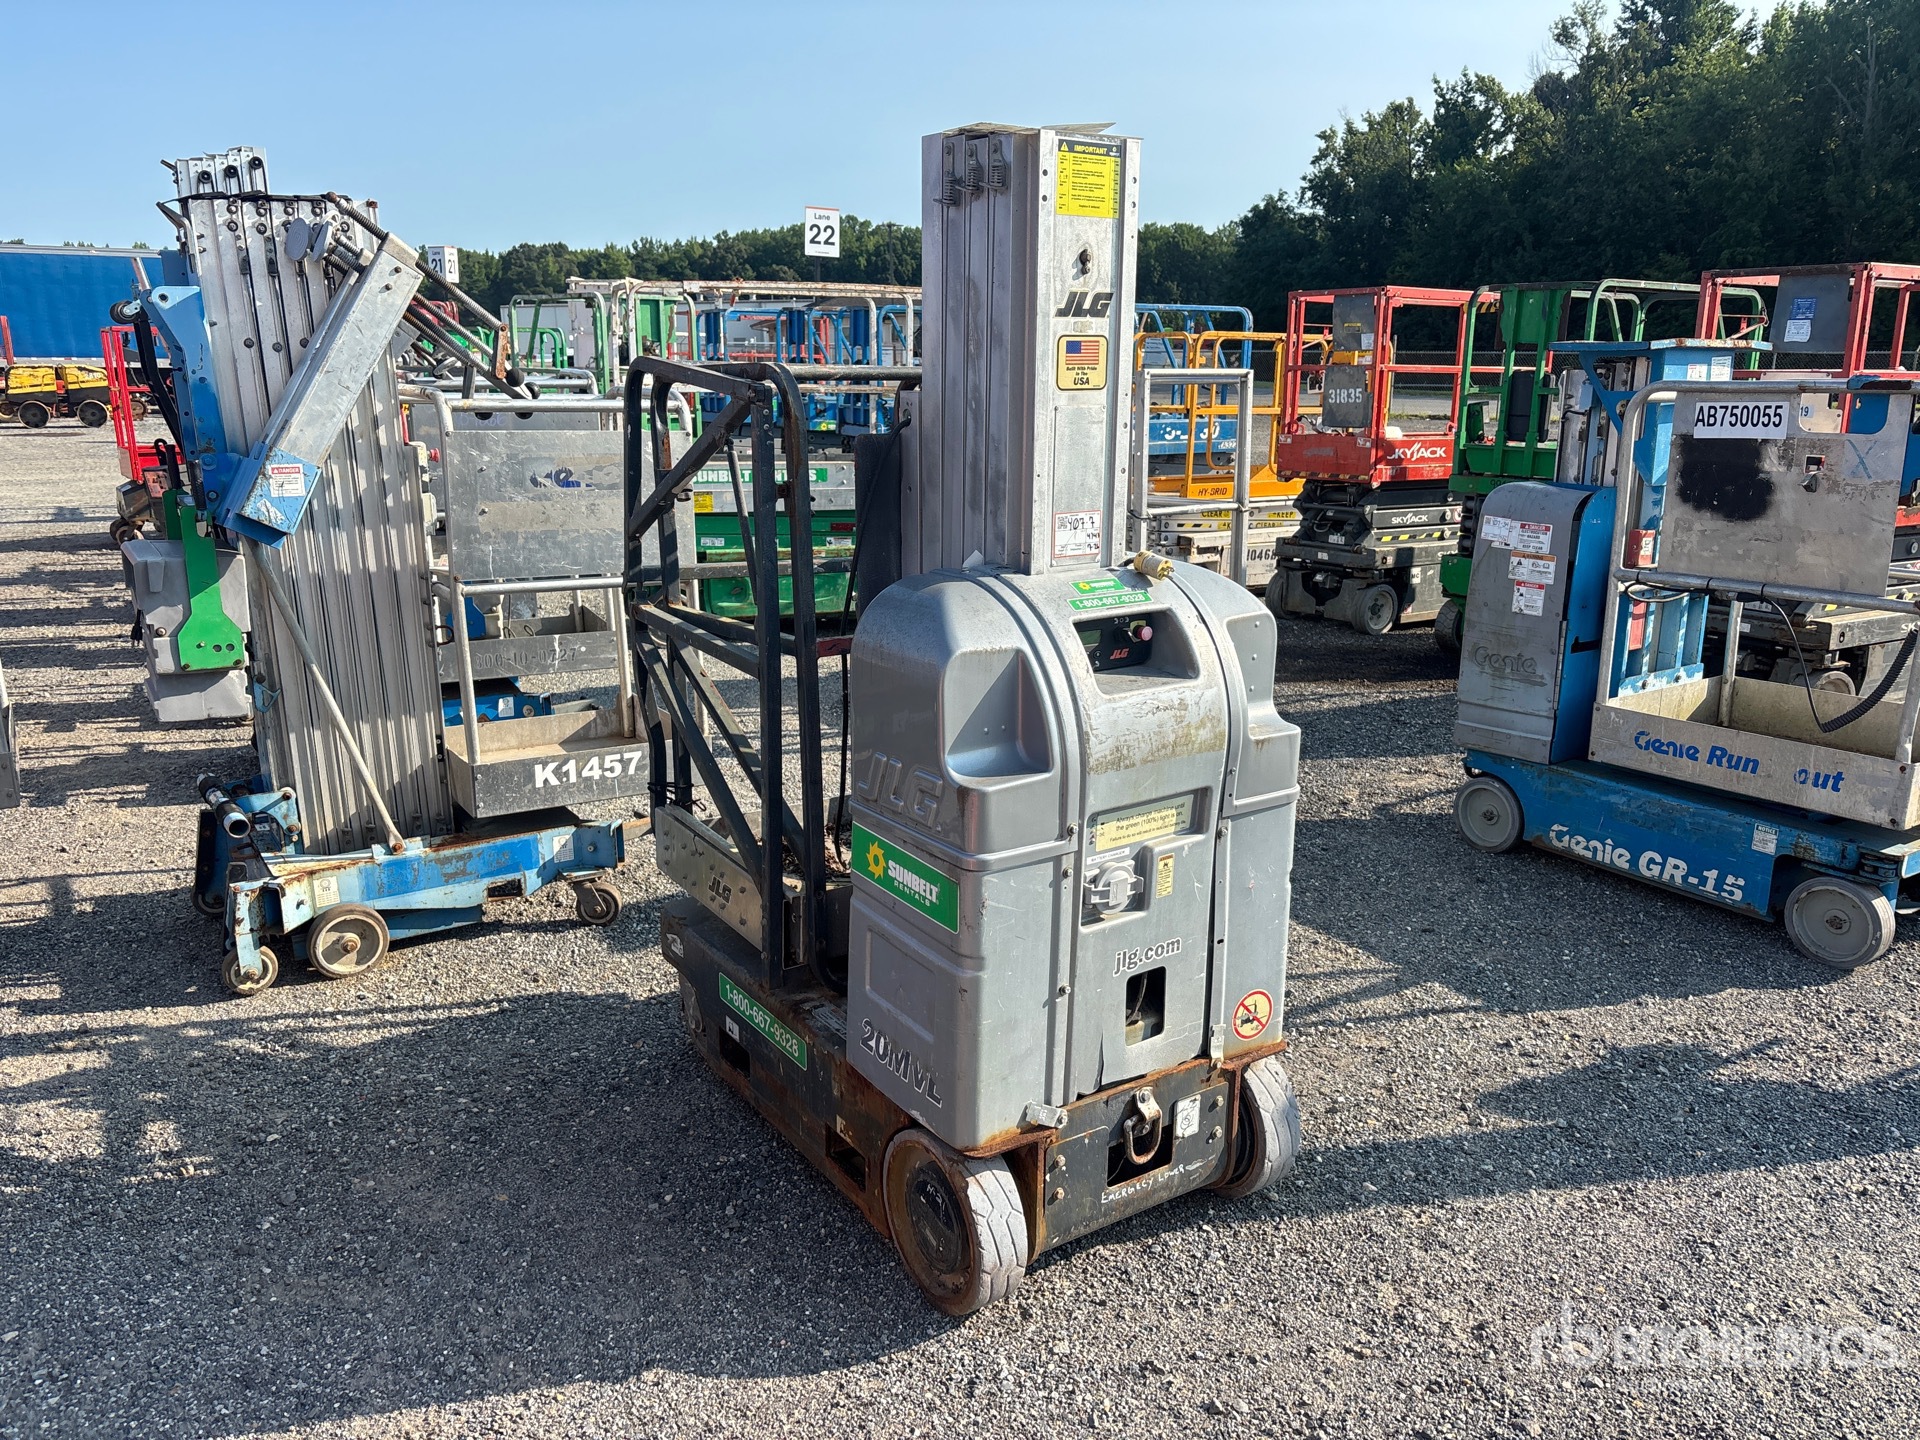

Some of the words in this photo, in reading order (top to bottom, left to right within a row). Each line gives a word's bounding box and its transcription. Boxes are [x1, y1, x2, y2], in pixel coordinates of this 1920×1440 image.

[1074, 144, 1107, 154] IMPORTANT
[809, 224, 835, 246] 22
[431, 258, 443, 273] 21
[448, 259, 456, 274] 21
[1055, 291, 1114, 318] JLG
[1073, 377, 1090, 385] USA
[1328, 388, 1362, 403] 31835
[1694, 405, 1783, 428] AB750055
[1387, 442, 1446, 461] SKYJACK
[1391, 512, 1428, 525] SKYJACK
[1075, 593, 1145, 608] 1-800-667-9328
[1110, 648, 1129, 660] JLG
[1475, 646, 1538, 675] Genie
[1634, 730, 1699, 762] Genie
[1707, 745, 1760, 774] Run
[534, 751, 642, 788] K1457
[858, 752, 943, 829] JLG
[1116, 813, 1134, 823] Always
[1136, 810, 1153, 819] charge
[1175, 802, 1185, 810] until
[1125, 820, 1140, 830] green
[1141, 815, 1159, 826] (100%)
[1758, 826, 1775, 834] NOTICE
[1550, 824, 1631, 870] Genie
[1639, 851, 1745, 902] GR-15
[708, 876, 732, 903] JLG
[888, 859, 938, 903] SUNBELT
[894, 880, 930, 907] RENTALS
[1114, 939, 1181, 976] jlg.com
[725, 984, 799, 1057] 1-800-667-9328
[860, 1018, 942, 1108] 20MVL
[1158, 1164, 1184, 1182] LOWER
